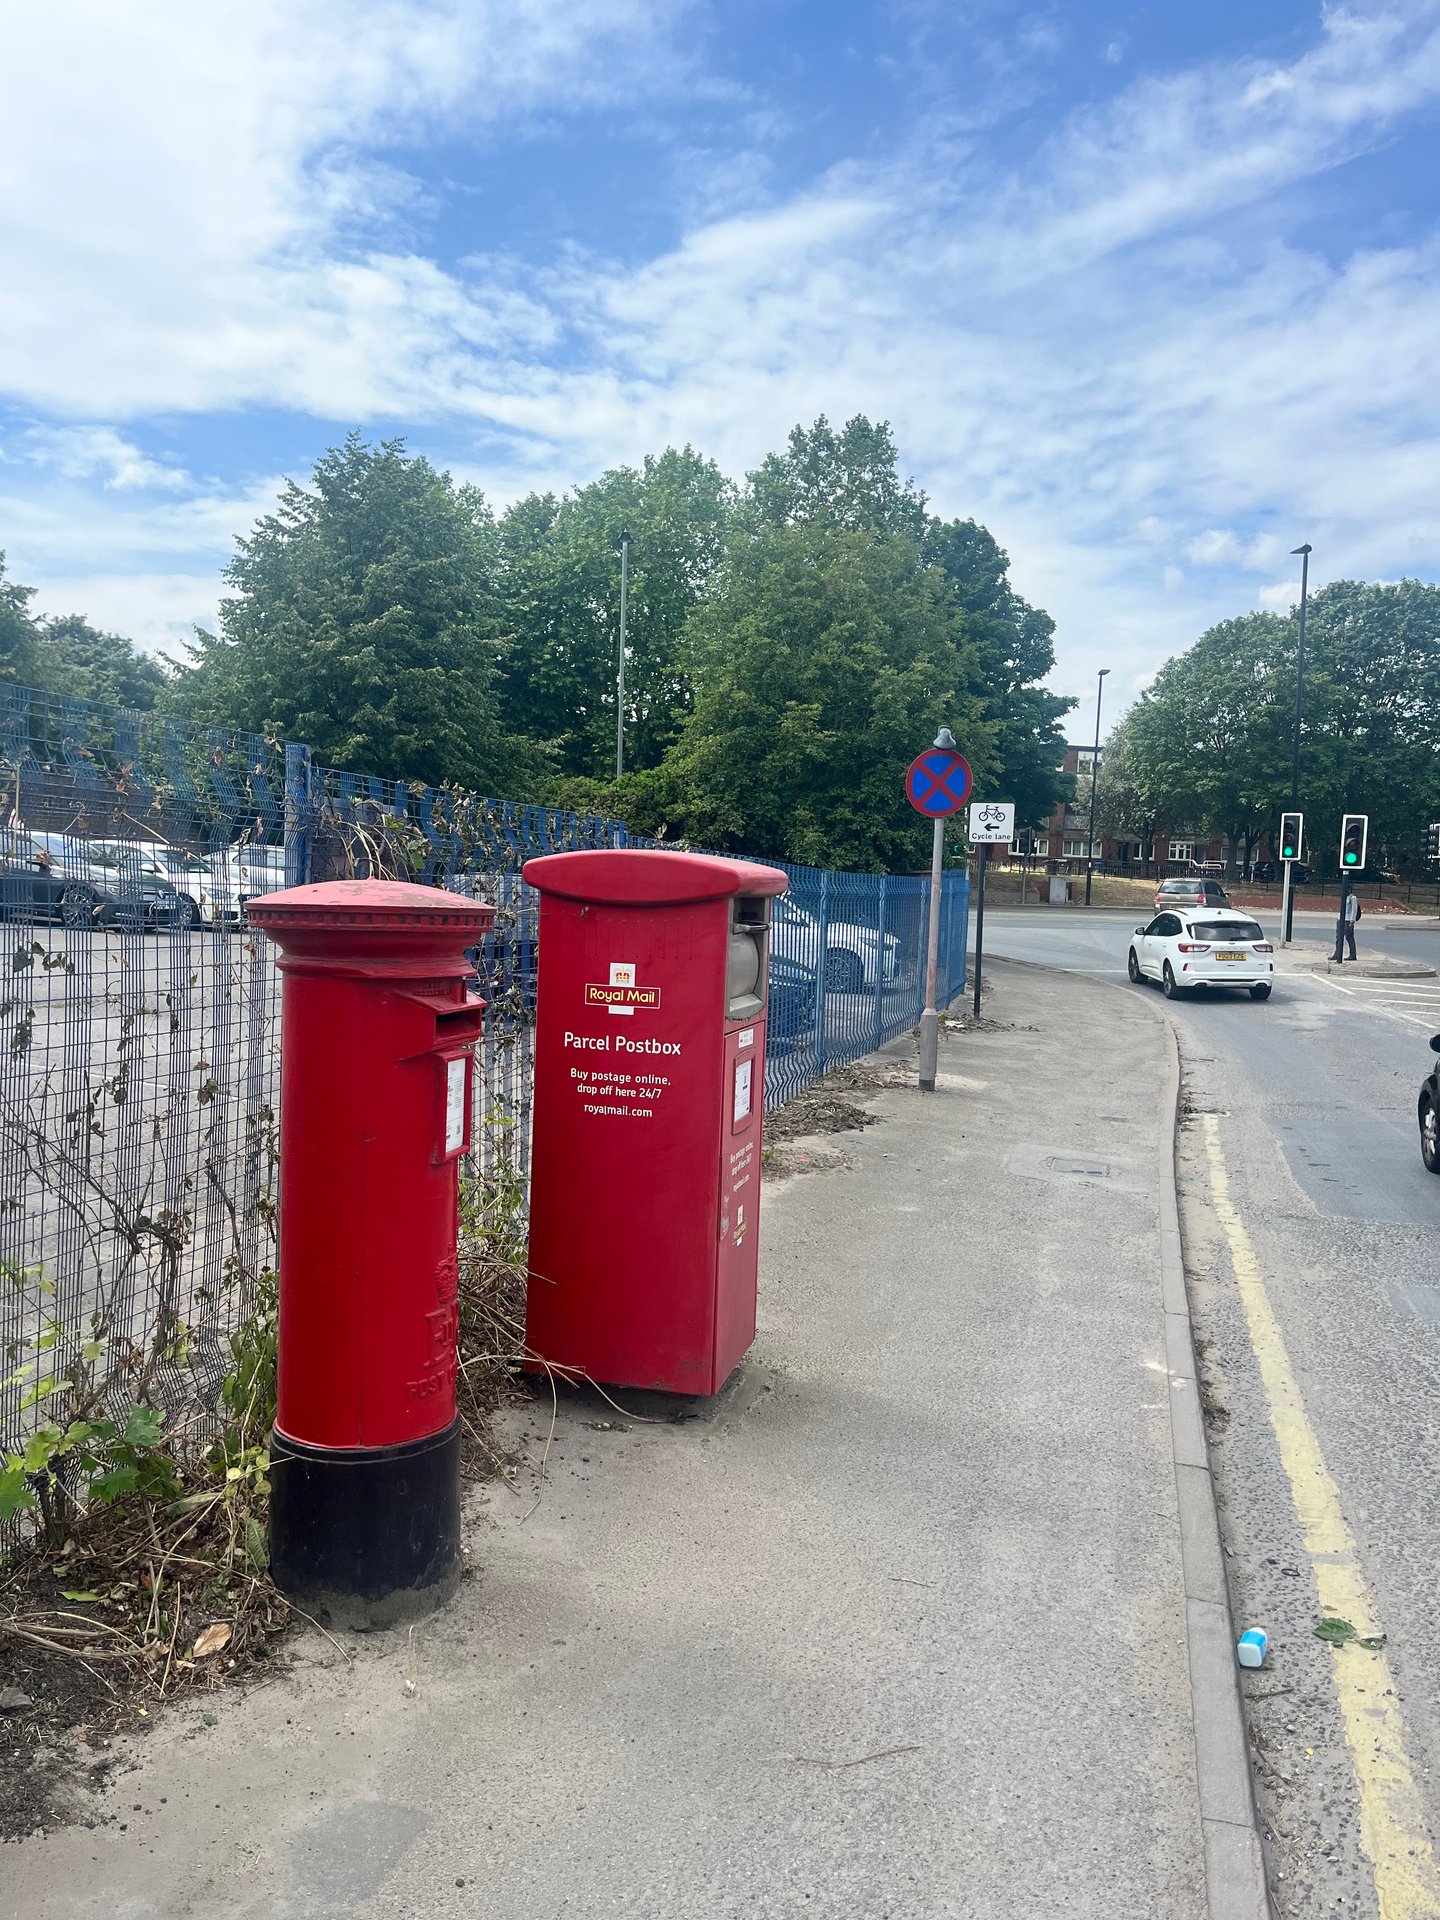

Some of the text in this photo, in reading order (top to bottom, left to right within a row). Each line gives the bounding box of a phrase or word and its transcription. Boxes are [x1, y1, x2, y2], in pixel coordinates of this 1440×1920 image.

[972, 832, 992, 840] Cycle
[590, 988, 655, 1003] Royal Mail
[564, 1031, 681, 1055] Parcel Postbox
[570, 1067, 671, 1086] Buy postage online,
[577, 1083, 662, 1099] drop off here 24/7
[584, 1103, 653, 1117] royalmail.com
[405, 1371, 445, 1402] POST
